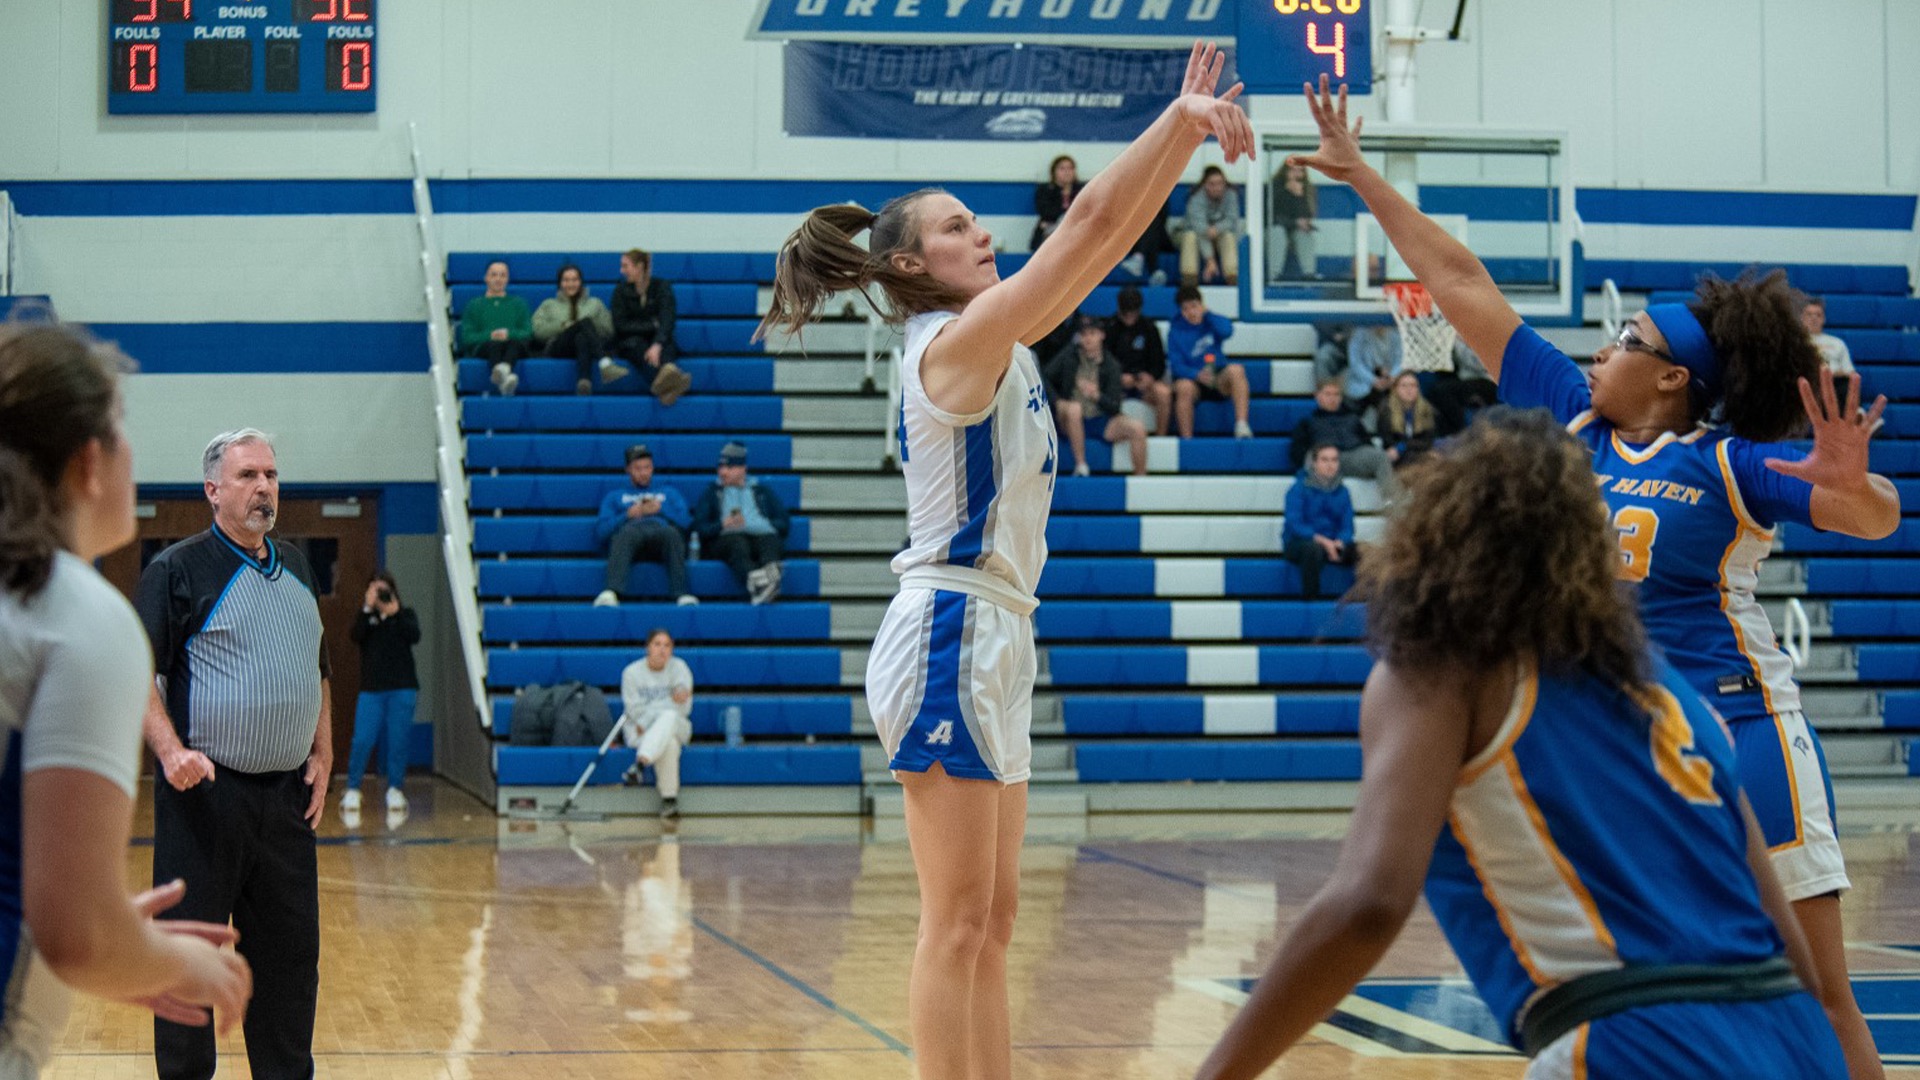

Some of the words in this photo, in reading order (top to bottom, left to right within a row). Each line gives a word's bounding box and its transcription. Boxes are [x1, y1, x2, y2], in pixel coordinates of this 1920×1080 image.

[218, 6, 268, 19] BONUS
[115, 27, 161, 39] FOULS
[194, 26, 246, 39] PLAYER
[264, 26, 302, 39] FOUL
[327, 25, 374, 39] FOULS
[1306, 22, 1345, 78] 4
[129, 44, 157, 92] 0
[341, 42, 370, 90] 0
[833, 42, 1015, 92] HOUND
[1023, 46, 1192, 95] POUN
[1610, 477, 1705, 506] HAVEN
[1599, 503, 1660, 582] 3
[925, 719, 954, 746] A
